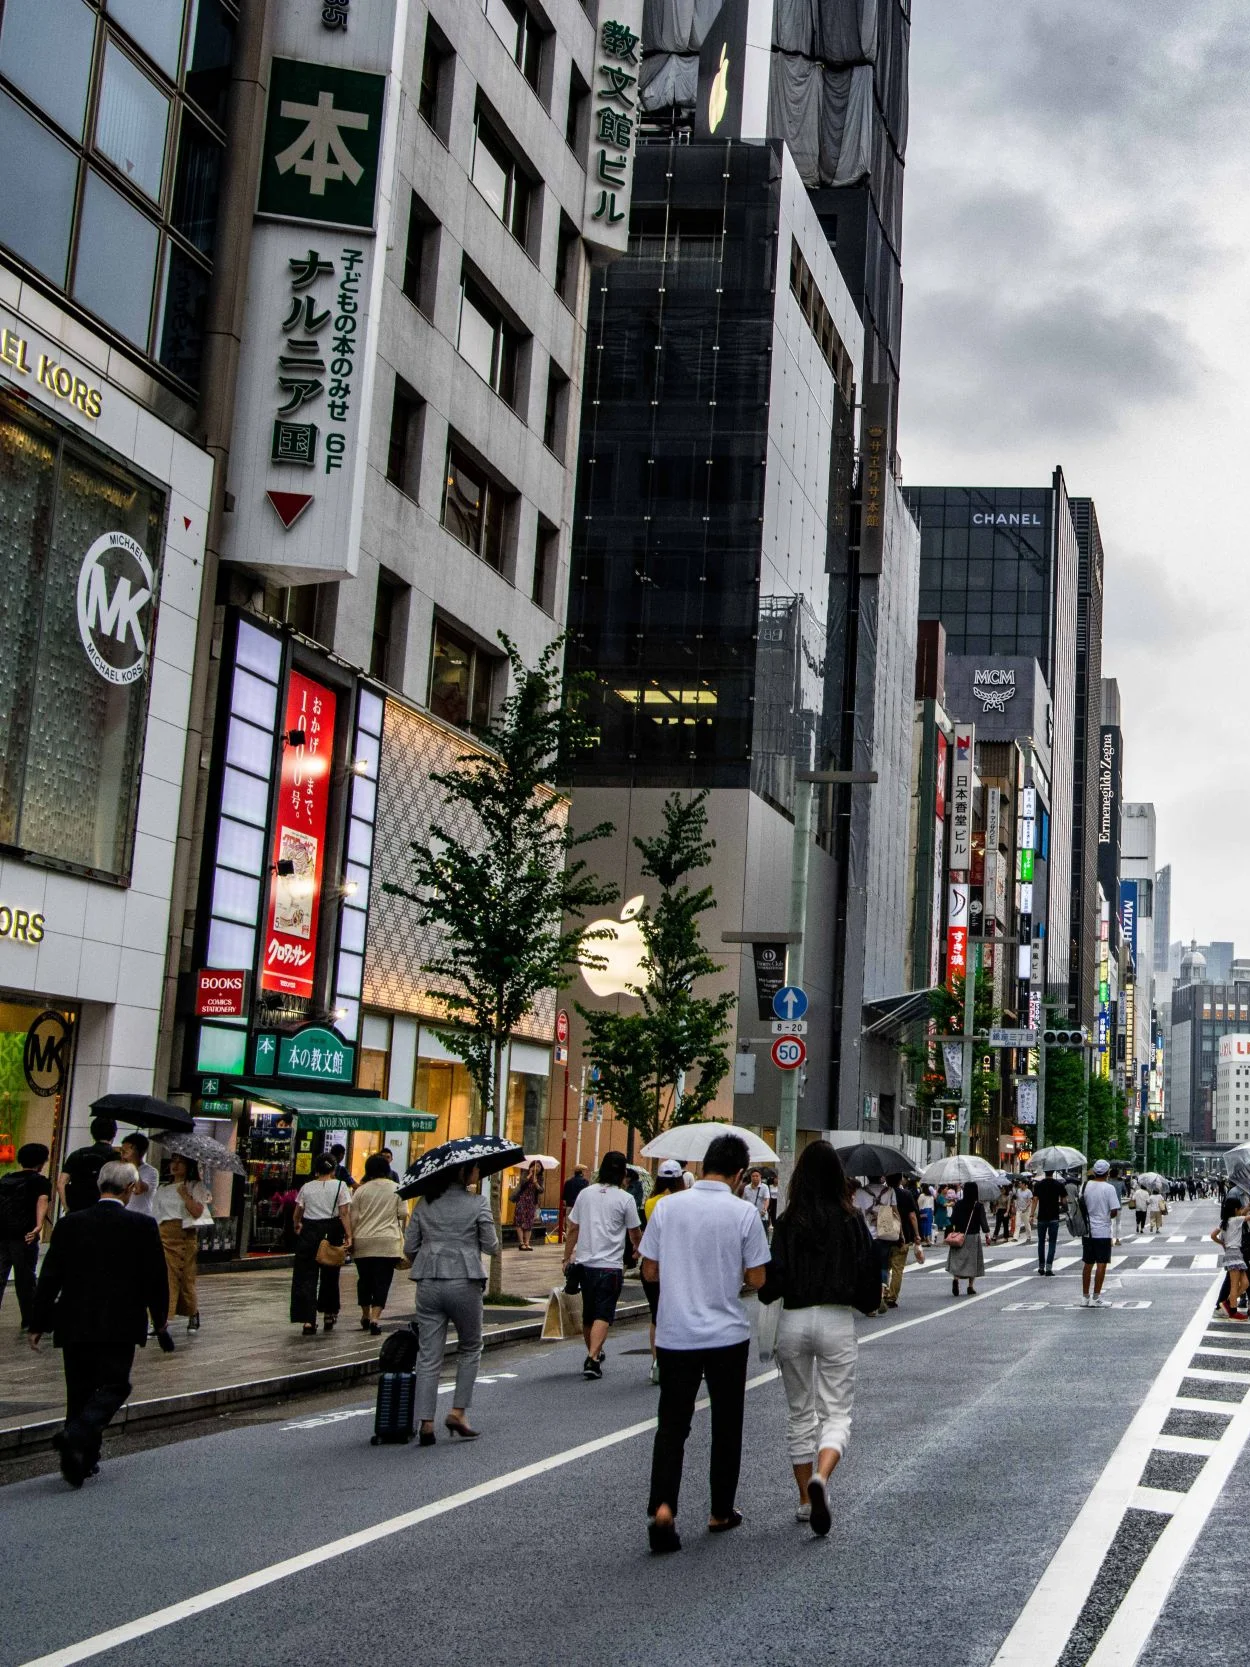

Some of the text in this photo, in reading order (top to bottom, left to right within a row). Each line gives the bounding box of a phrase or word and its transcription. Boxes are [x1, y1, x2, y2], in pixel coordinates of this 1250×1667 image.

[593, 20, 640, 222] 教文館ビル
[274, 91, 369, 196] 本
[272, 250, 335, 466] ナルニア国
[325, 248, 364, 474] 子どもの本のみせ 6F
[0, 328, 103, 420] EL KORS
[973, 513, 1041, 526] CHANEL
[109, 534, 144, 562] MICHAEL
[87, 562, 151, 654] MK
[86, 643, 143, 682] MICHAEL KORS
[974, 670, 1015, 685] MCM
[1099, 734, 1115, 844] Ermenegildo Zegna
[954, 776, 968, 854] 日本香堂ビル
[1123, 805, 1148, 818] LA
[1123, 900, 1134, 941] MIZUH
[268, 938, 312, 967] クロワッサン
[201, 977, 242, 989] BOOKS
[207, 998, 232, 1006] COMICS
[258, 1038, 274, 1054] 本
[288, 1045, 344, 1074] 本の教文館
[779, 1045, 799, 1060] 50
[204, 1079, 217, 1093] 本
